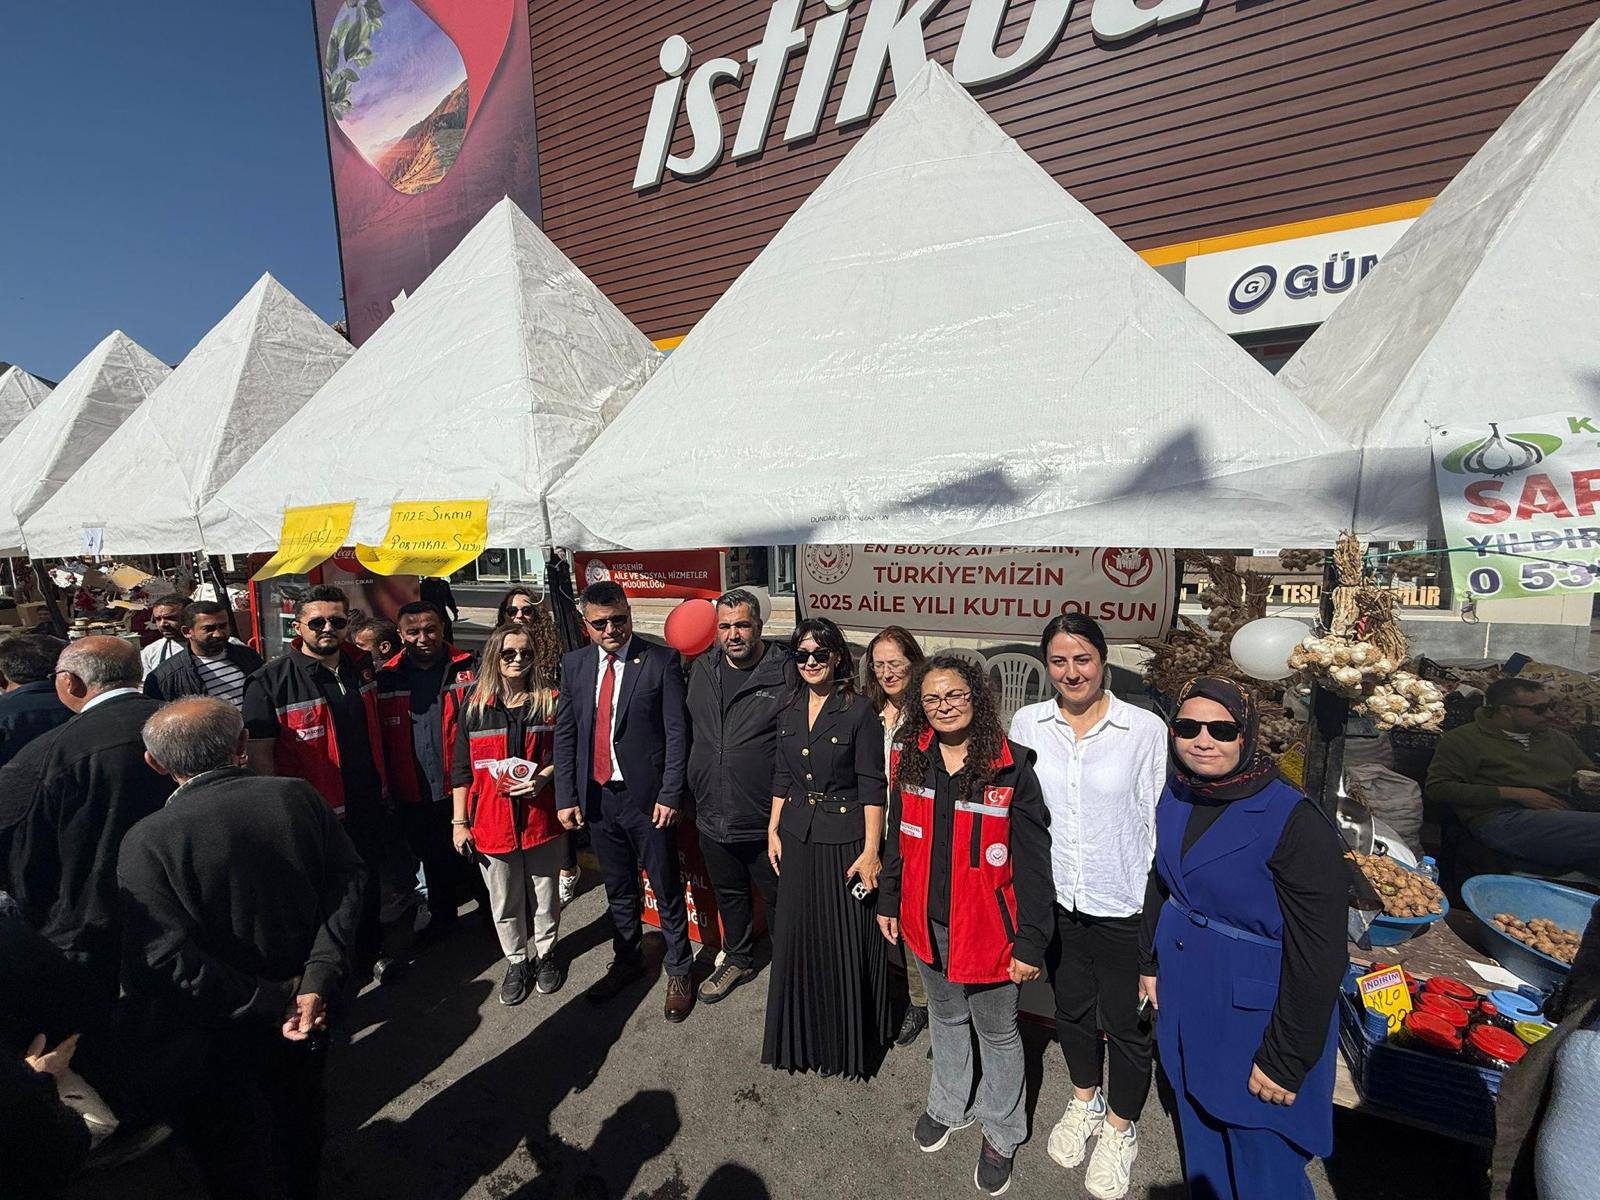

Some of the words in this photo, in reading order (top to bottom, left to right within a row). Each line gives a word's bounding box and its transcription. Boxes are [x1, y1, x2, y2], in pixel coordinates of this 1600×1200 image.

[863, 544, 888, 553] EN
[894, 544, 961, 556] BÜYÜK
[629, 572, 639, 580] VE
[640, 571, 666, 580] SOSYAL
[668, 570, 708, 579] HİZMETLER
[1520, 560, 1600, 590] 53
[1281, 584, 1320, 603] TESL
[809, 594, 852, 611] 2025
[858, 590, 905, 612] AİLE
[911, 597, 954, 615] YILI
[963, 597, 1051, 618] KUTLU
[1061, 600, 1156, 622] OLSUN
